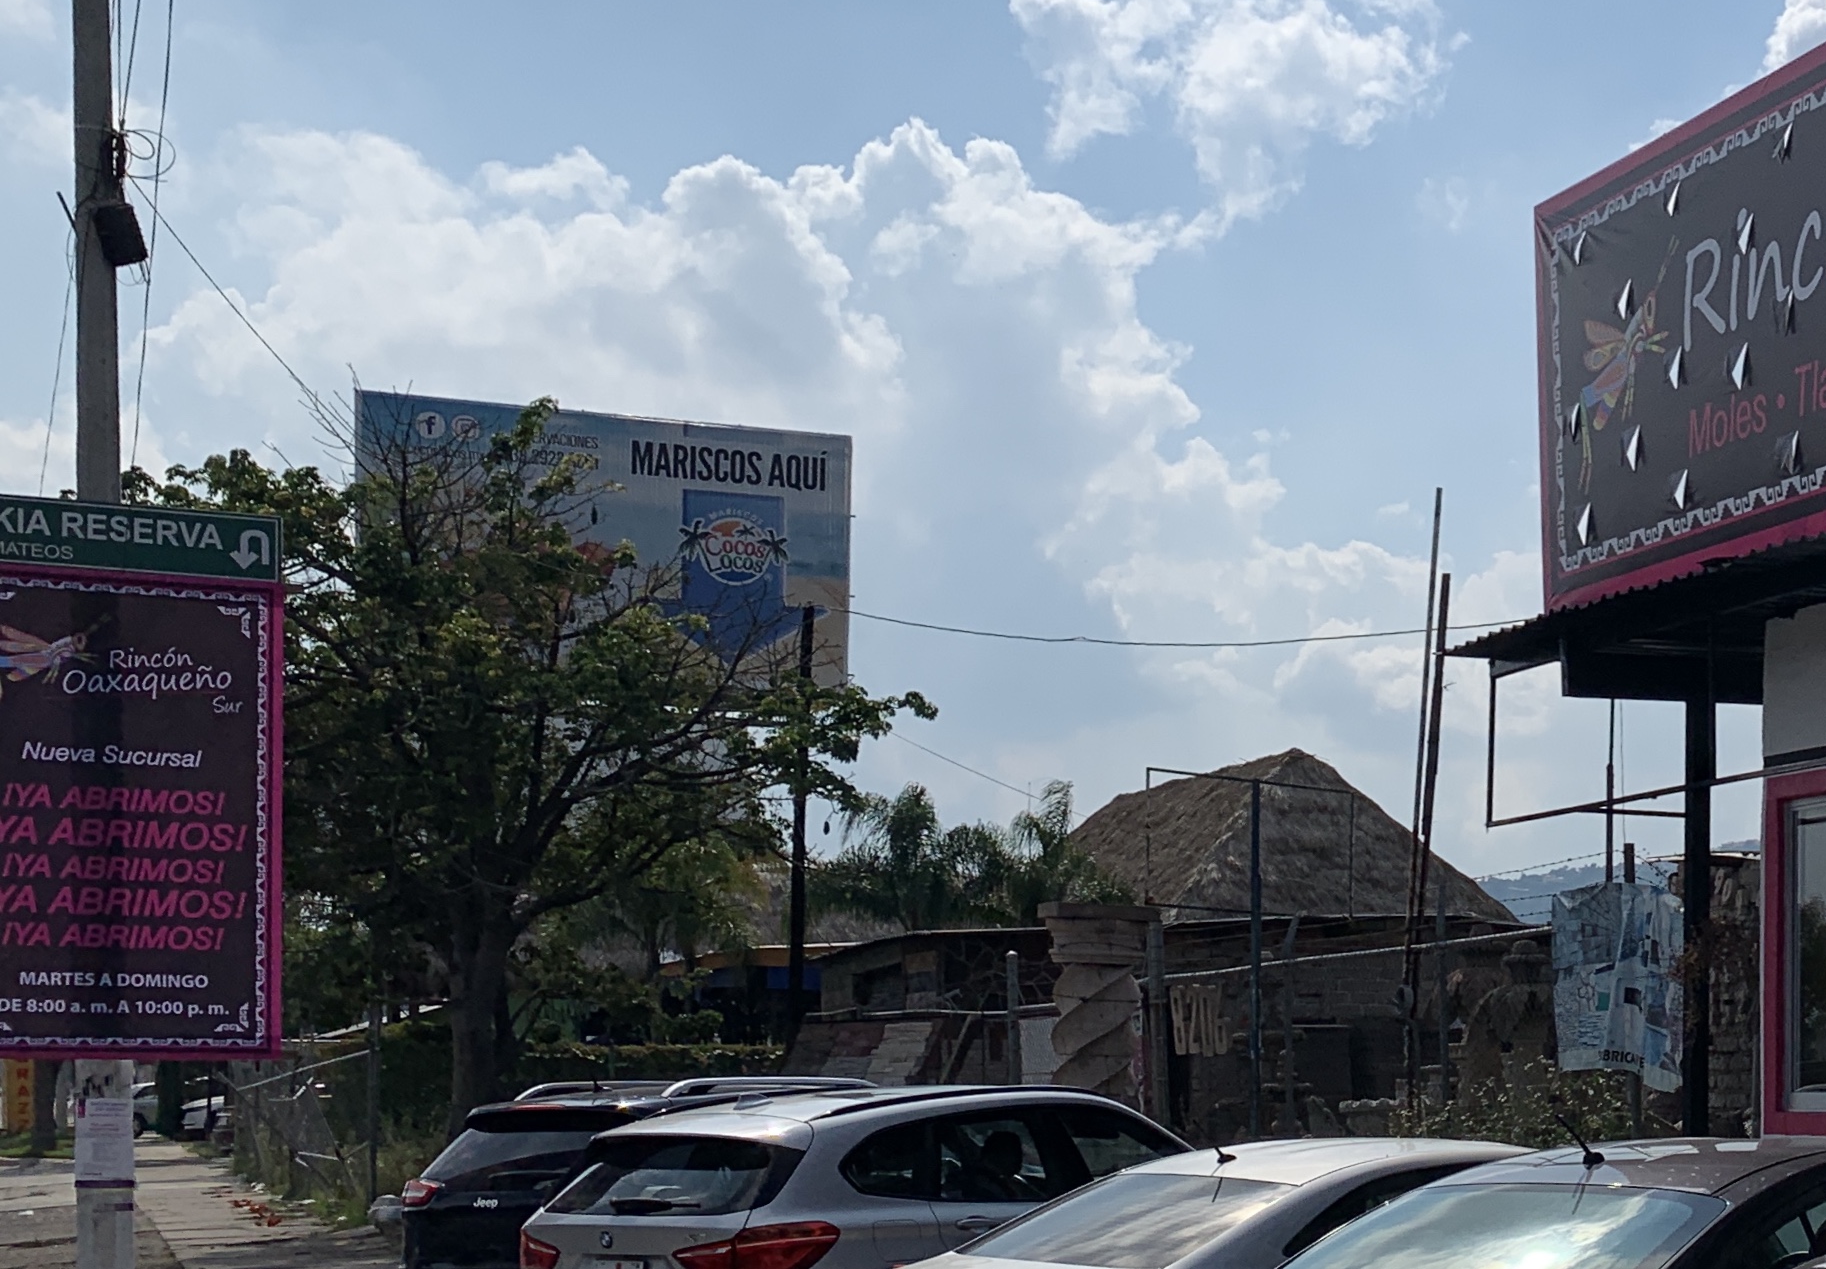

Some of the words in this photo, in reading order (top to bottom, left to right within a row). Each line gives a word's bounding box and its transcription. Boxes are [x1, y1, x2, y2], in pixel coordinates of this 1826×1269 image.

[1688, 392, 1767, 459] Moles
[630, 439, 763, 486] MARISCOS
[767, 449, 828, 492] AQUÍ
[61, 511, 223, 550] RESERVA
[109, 646, 193, 670] Rincón
[62, 665, 232, 700] Oaxaqueño
[212, 695, 244, 714] Sur
[21, 740, 96, 763] Nueva
[102, 744, 203, 768] Sucursal
[59, 785, 226, 816] ABRIMOS!
[48, 817, 248, 852] ABRIMOS!
[59, 855, 225, 884] ABRIMOS!
[47, 886, 248, 920] ABRIMOS!
[58, 923, 225, 951] ABRIMOS!
[19, 971, 96, 987] MARTES
[98, 972, 113, 987] A
[117, 972, 209, 989] DOMINGO
[0, 998, 22, 1012] DE
[26, 998, 66, 1013] 8:00
[116, 999, 131, 1014] A
[135, 1000, 184, 1015] 10:00
[473, 1196, 499, 1209] Jeep
